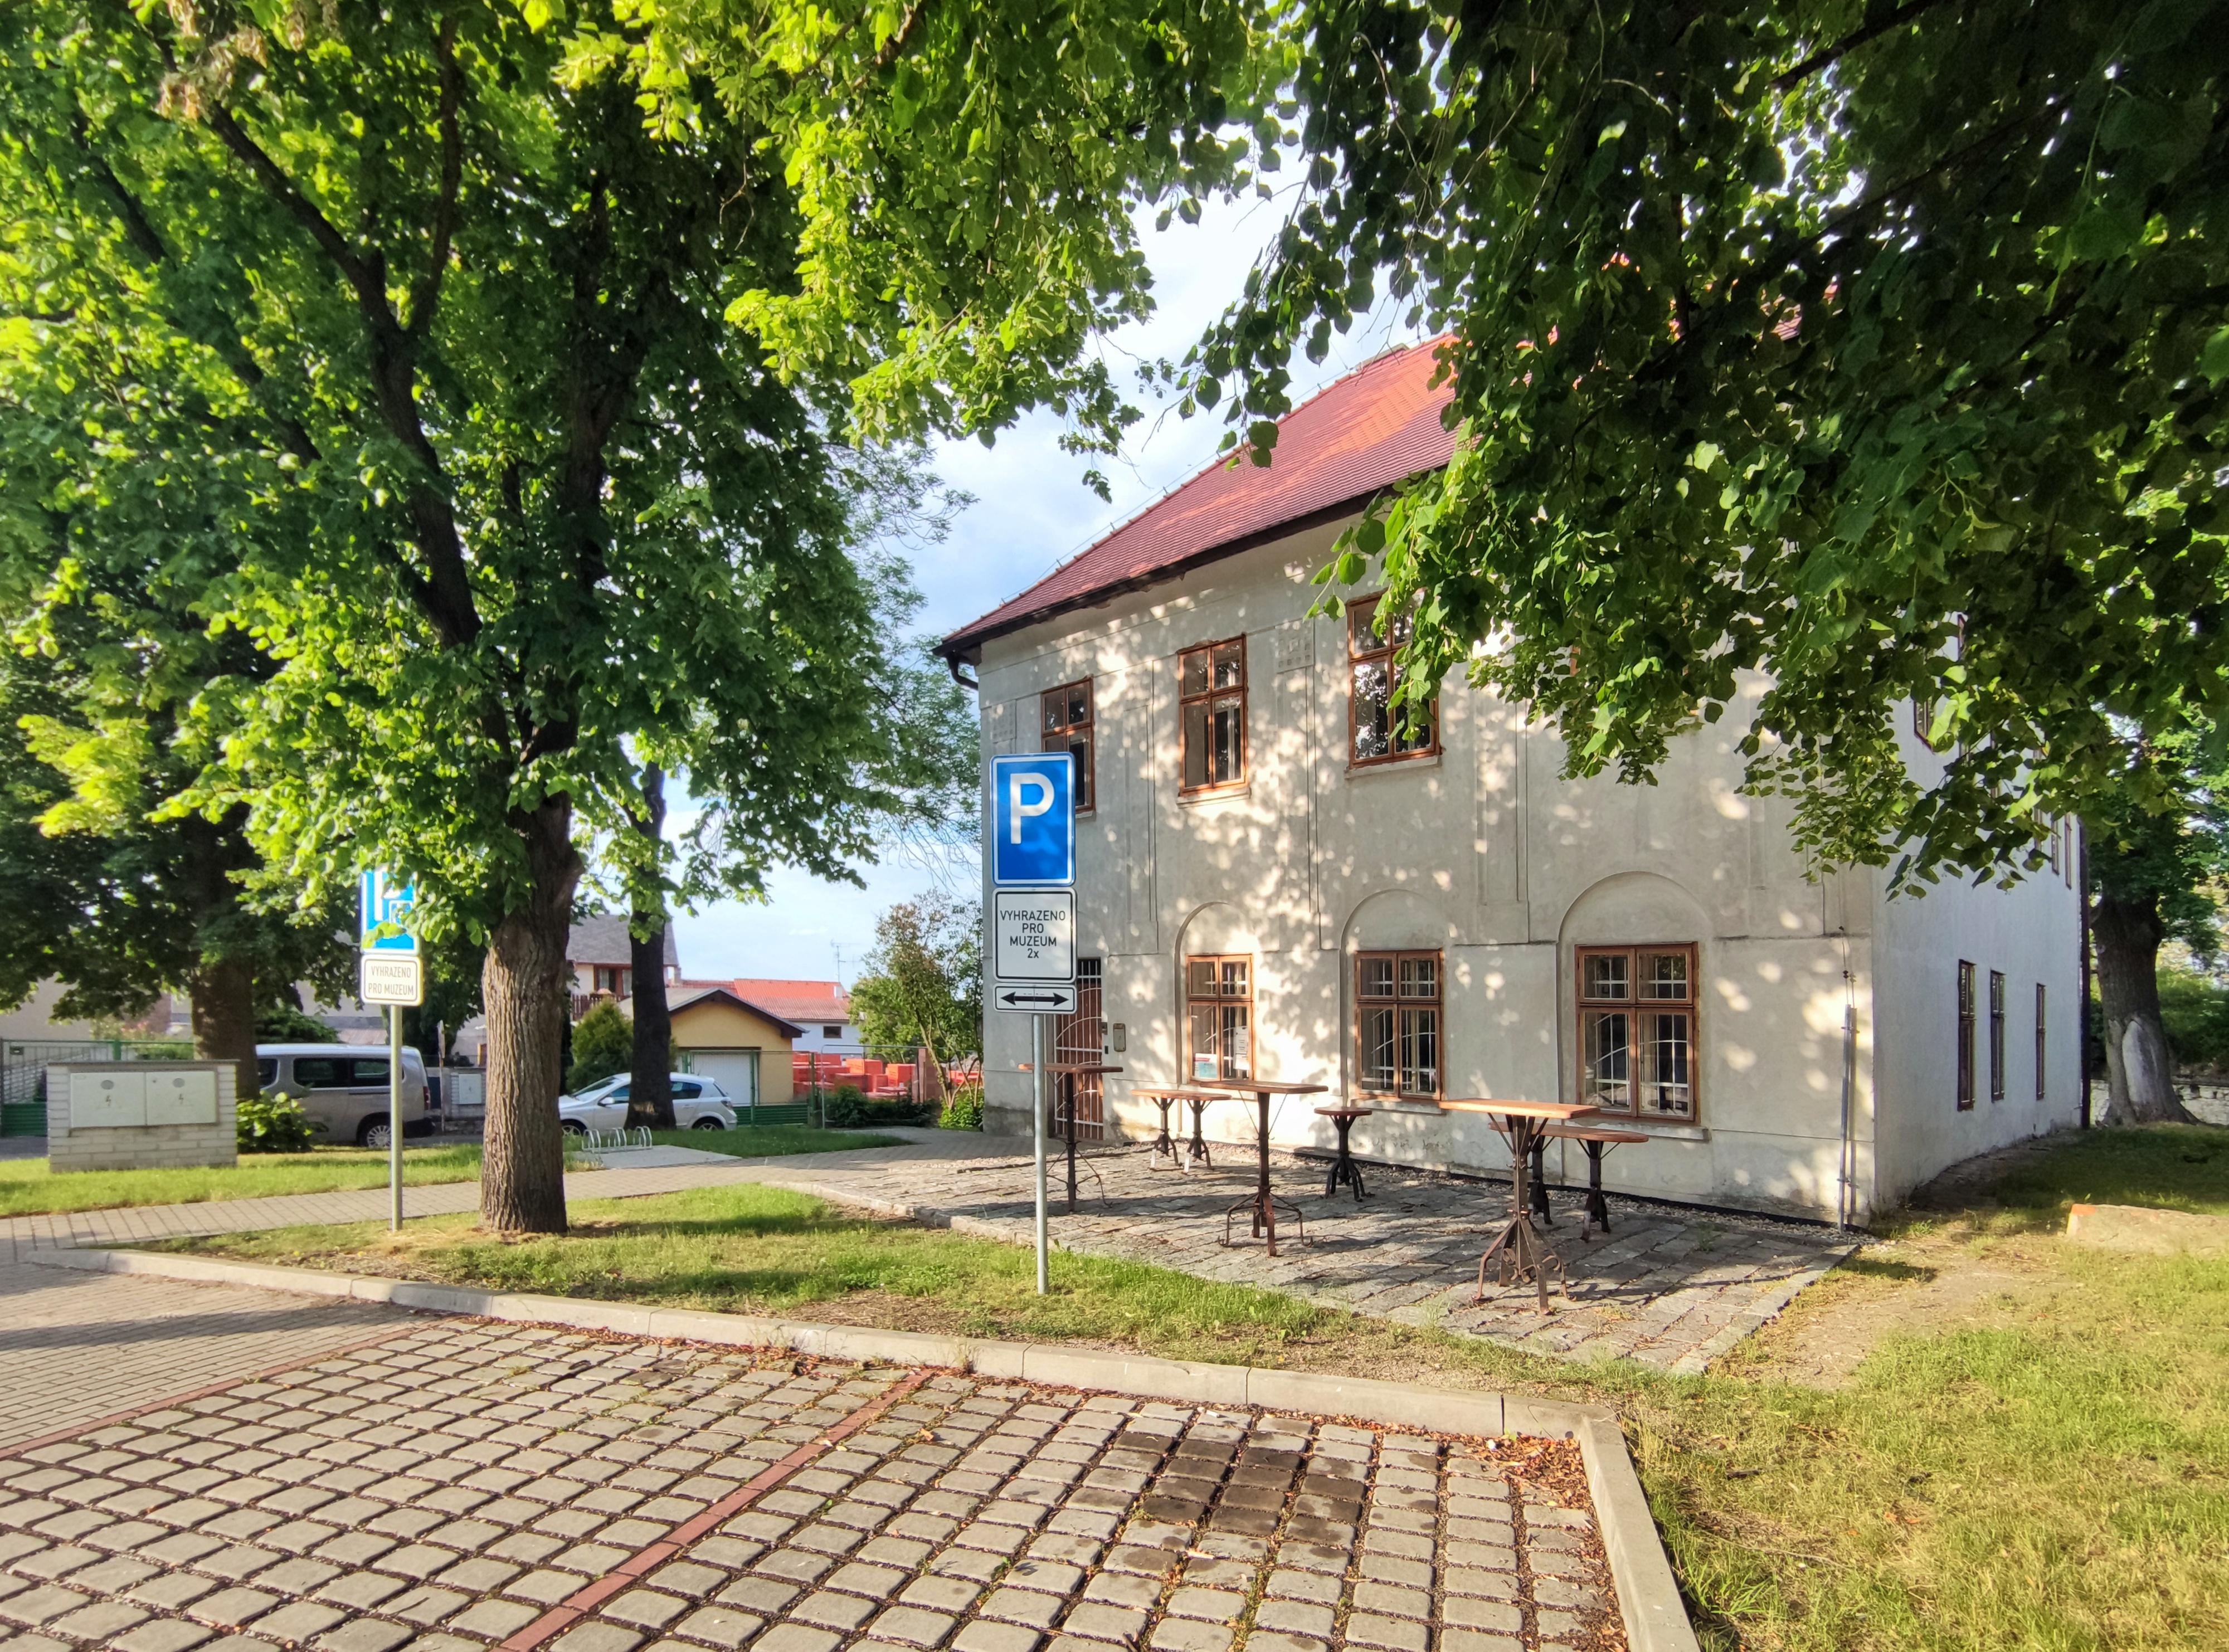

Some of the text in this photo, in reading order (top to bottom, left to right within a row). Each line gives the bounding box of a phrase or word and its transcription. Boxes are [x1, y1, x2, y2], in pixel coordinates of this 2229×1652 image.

[1010, 773, 1055, 845] P
[1000, 910, 1065, 921] VYHRAZENO
[1022, 923, 1044, 933] PRO
[1010, 935, 1057, 947] MUZEUM
[1027, 948, 1039, 958] 2x
[371, 965, 411, 978] VYHRAZENO
[368, 983, 414, 996] PRO MUZEUM
